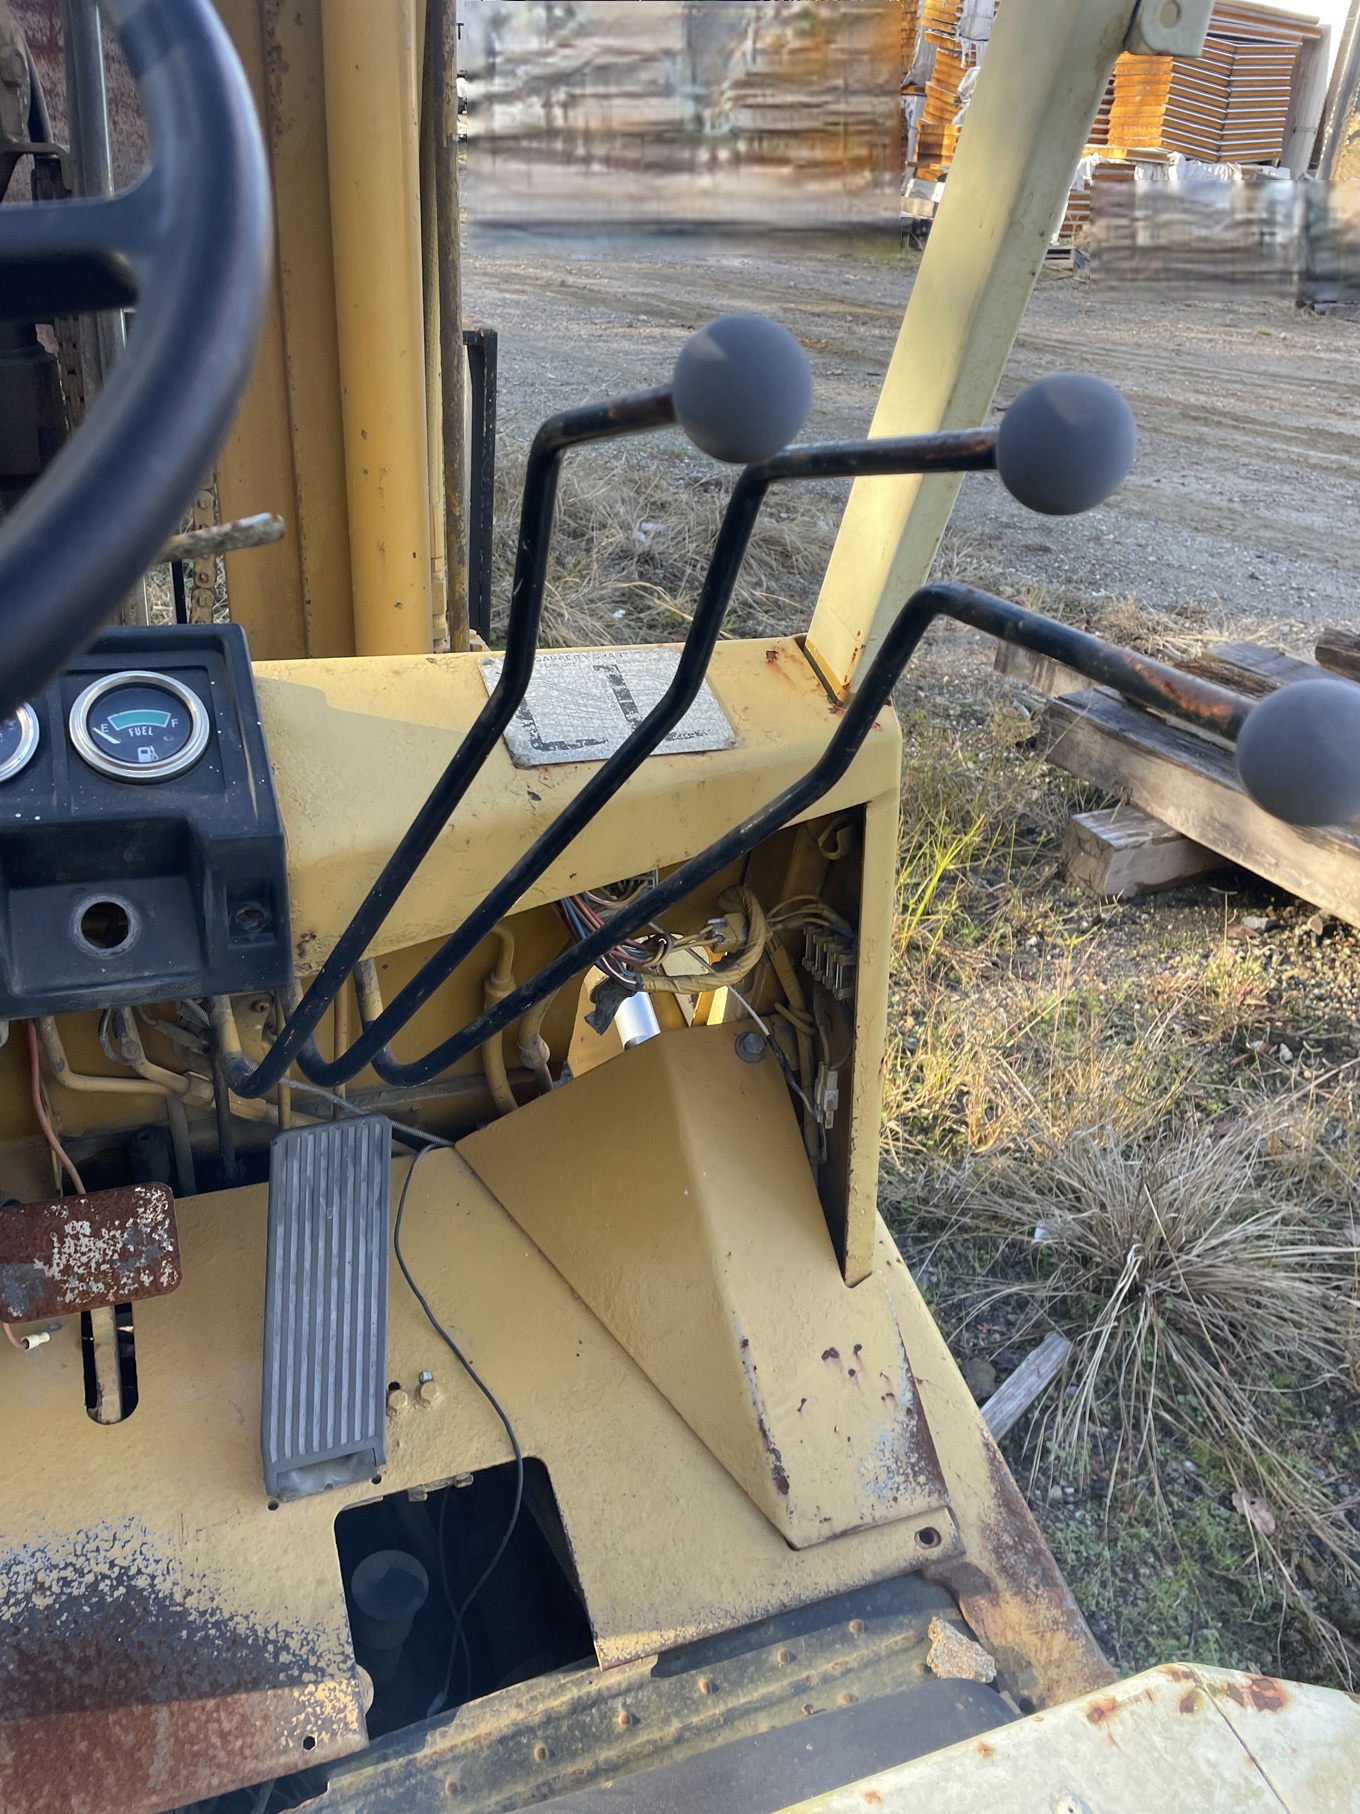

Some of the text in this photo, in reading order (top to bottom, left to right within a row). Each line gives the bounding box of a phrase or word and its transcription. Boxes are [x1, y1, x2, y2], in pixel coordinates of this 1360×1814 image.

[100, 723, 110, 733] E
[171, 718, 179, 728] F
[128, 726, 154, 737] FUEL
